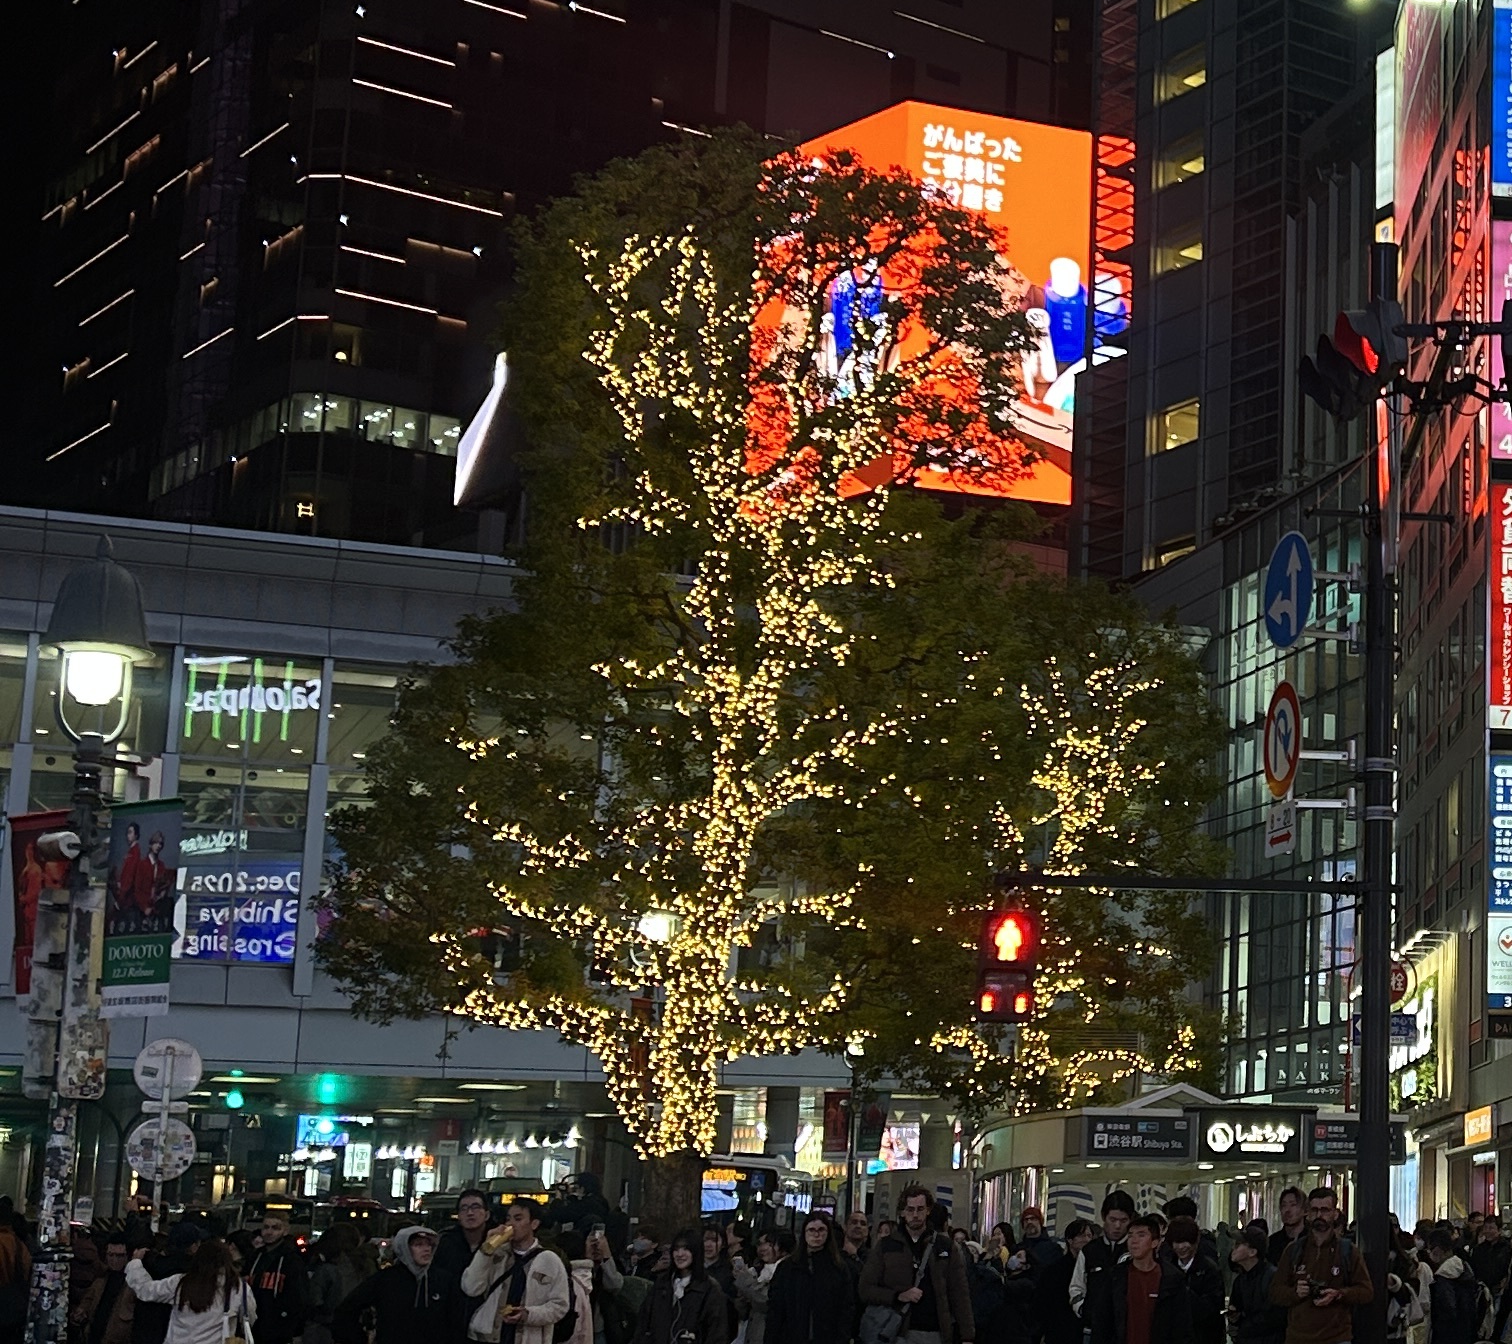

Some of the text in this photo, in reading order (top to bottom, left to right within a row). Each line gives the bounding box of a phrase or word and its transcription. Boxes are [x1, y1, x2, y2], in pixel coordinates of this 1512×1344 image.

[923, 123, 1022, 162] がんばった
[108, 943, 164, 962] DOMOTO
[1108, 1135, 1143, 1148] 渋谷駅
